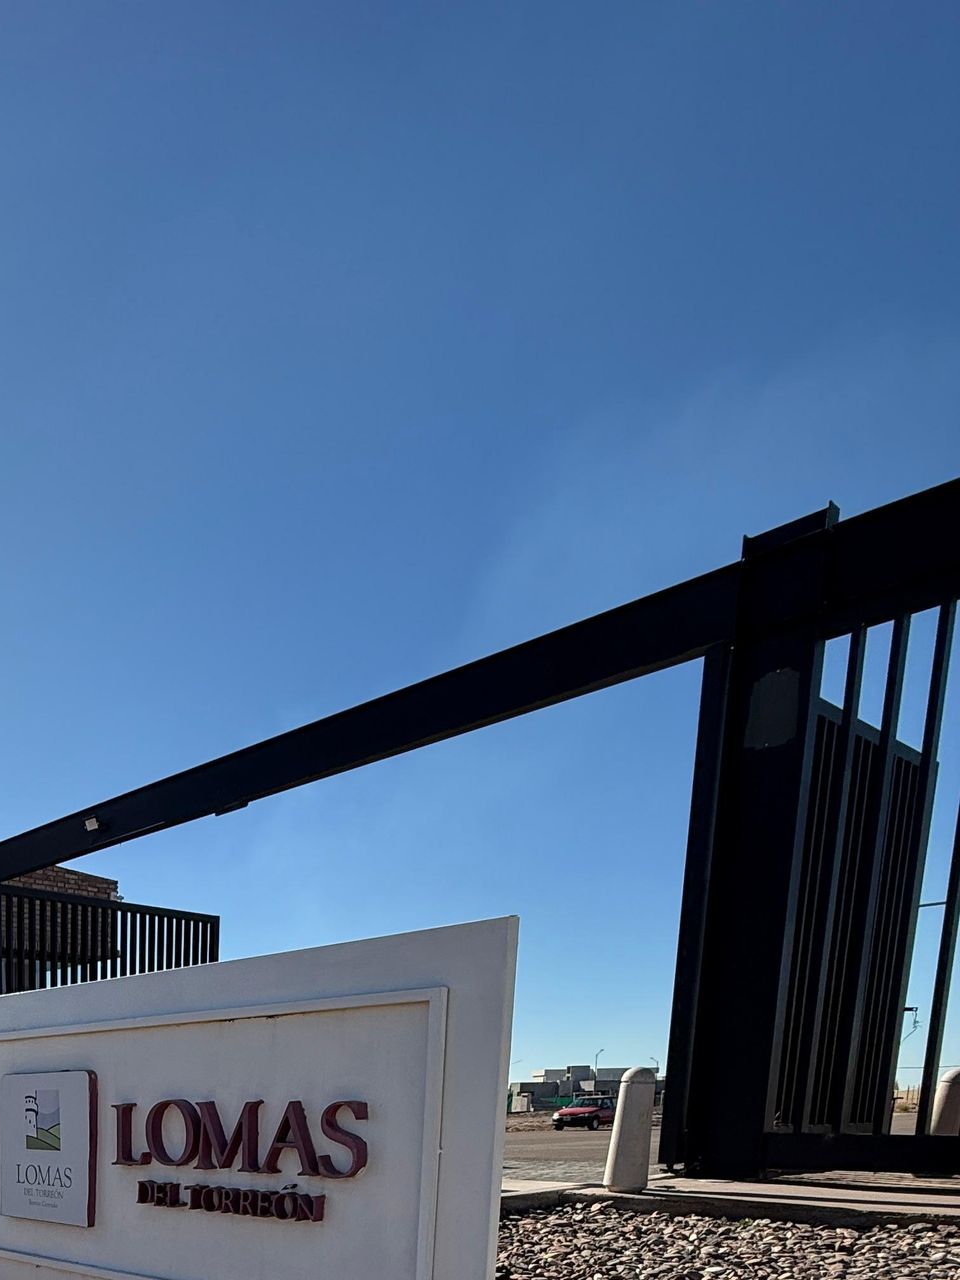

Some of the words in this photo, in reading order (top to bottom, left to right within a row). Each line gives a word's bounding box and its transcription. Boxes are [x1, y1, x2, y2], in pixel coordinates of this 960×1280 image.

[111, 1099, 368, 1178] LOMAS
[16, 1164, 72, 1188] LOMAS
[136, 1180, 188, 1207] DEL
[184, 1183, 326, 1222] TORREÓN
